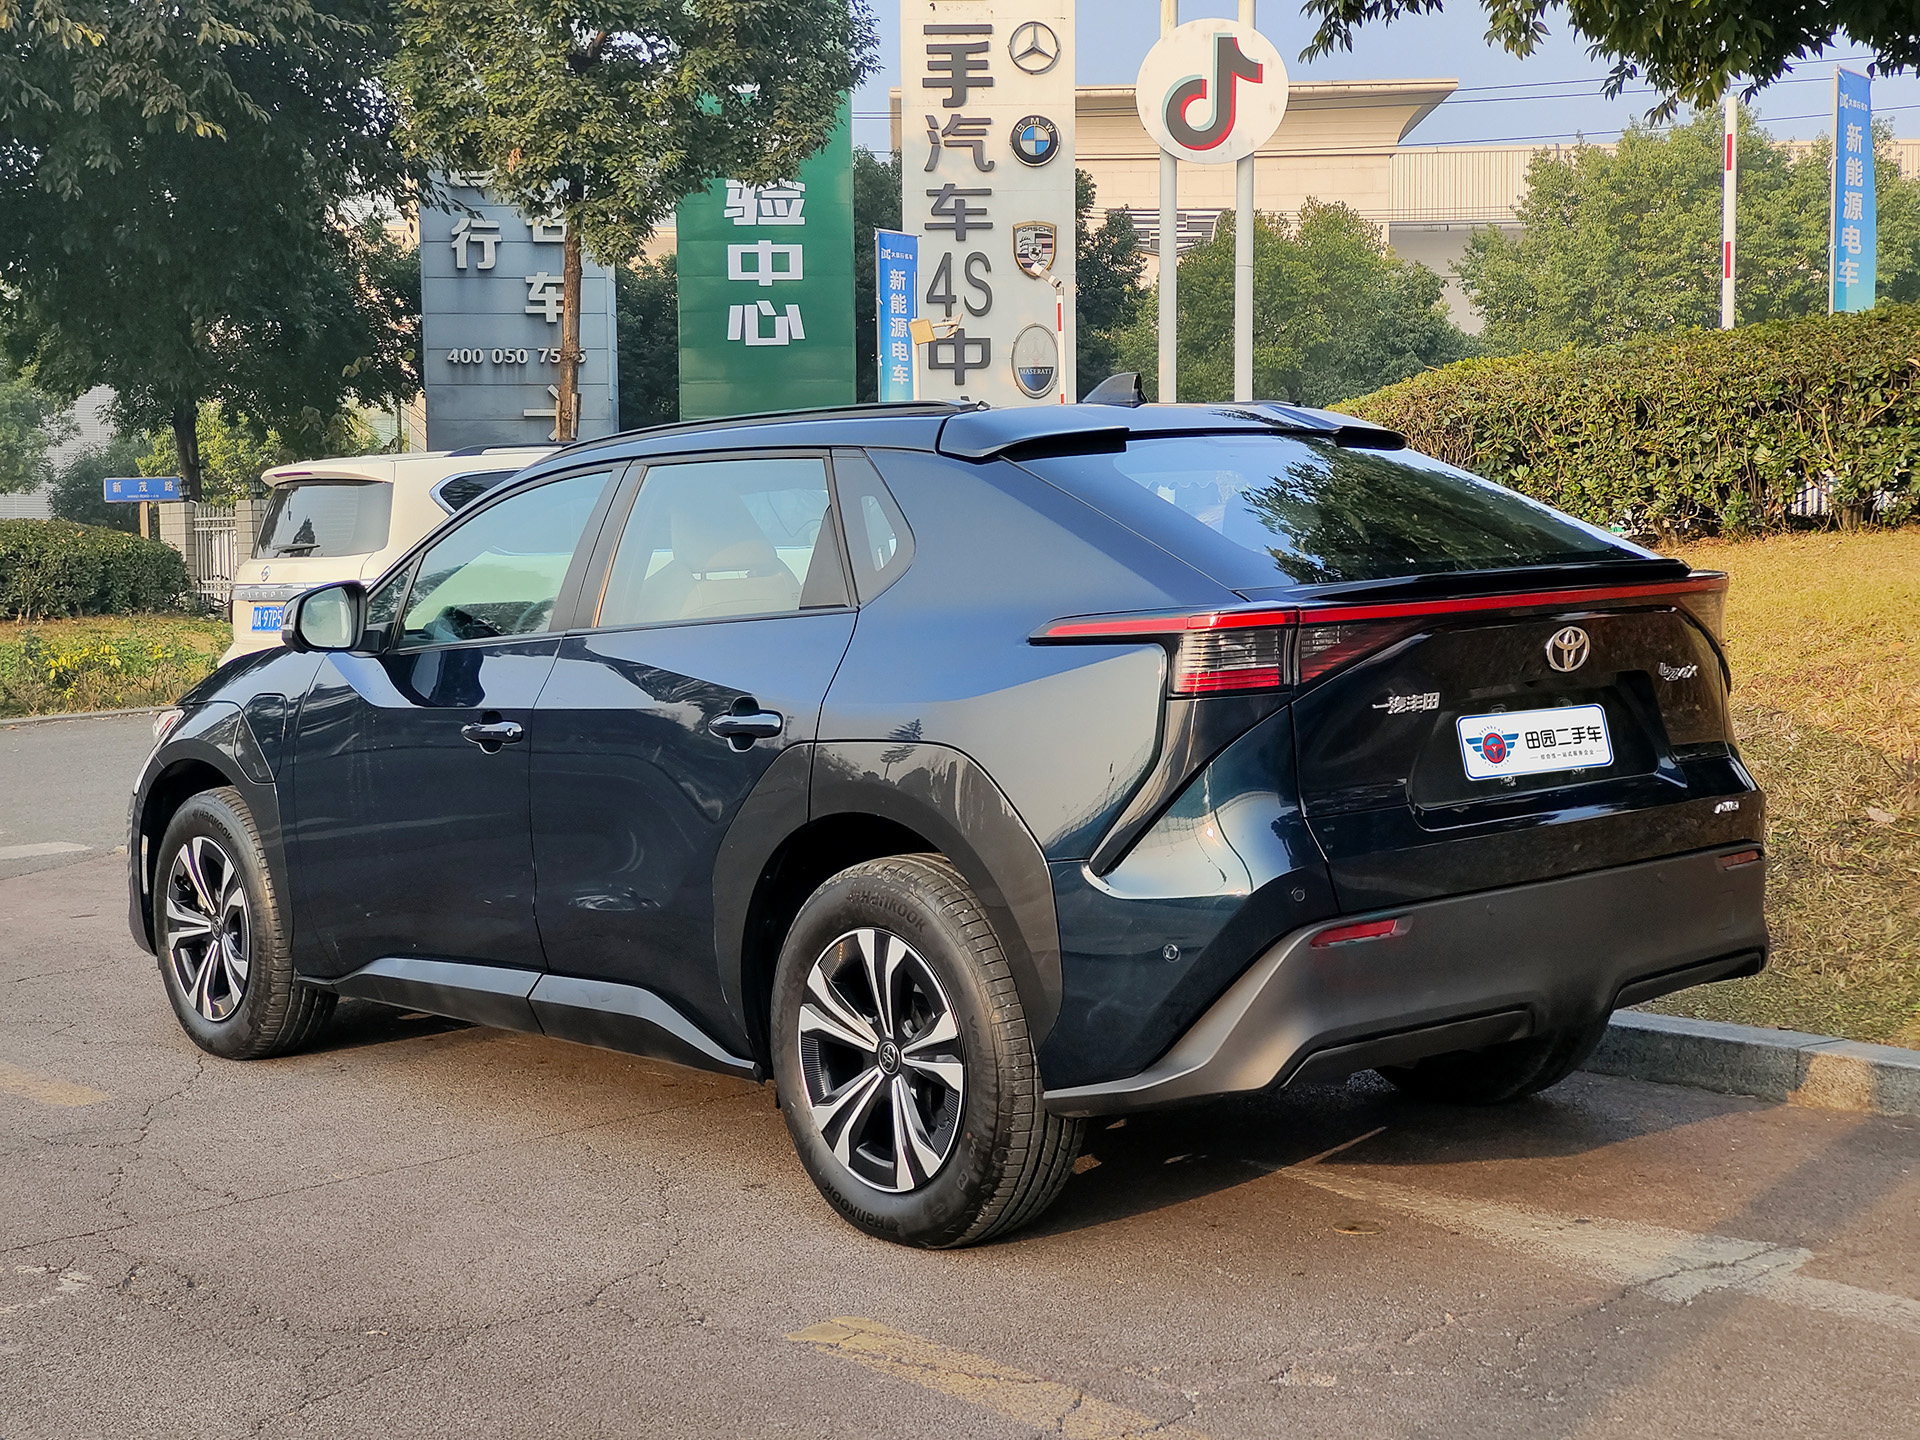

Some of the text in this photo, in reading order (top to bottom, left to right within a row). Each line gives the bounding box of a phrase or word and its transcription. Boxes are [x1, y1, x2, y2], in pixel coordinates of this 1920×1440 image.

[1015, 116, 1055, 134] BMW
[1836, 122, 1864, 288] 新能源电车
[889, 268, 910, 385] 新能源电车
[446, 348, 484, 364] 400
[491, 348, 529, 364] 050
[1019, 367, 1052, 376] MASERATI
[112, 480, 174, 493] 新茂路
[1525, 725, 1603, 749] 田园二手车
